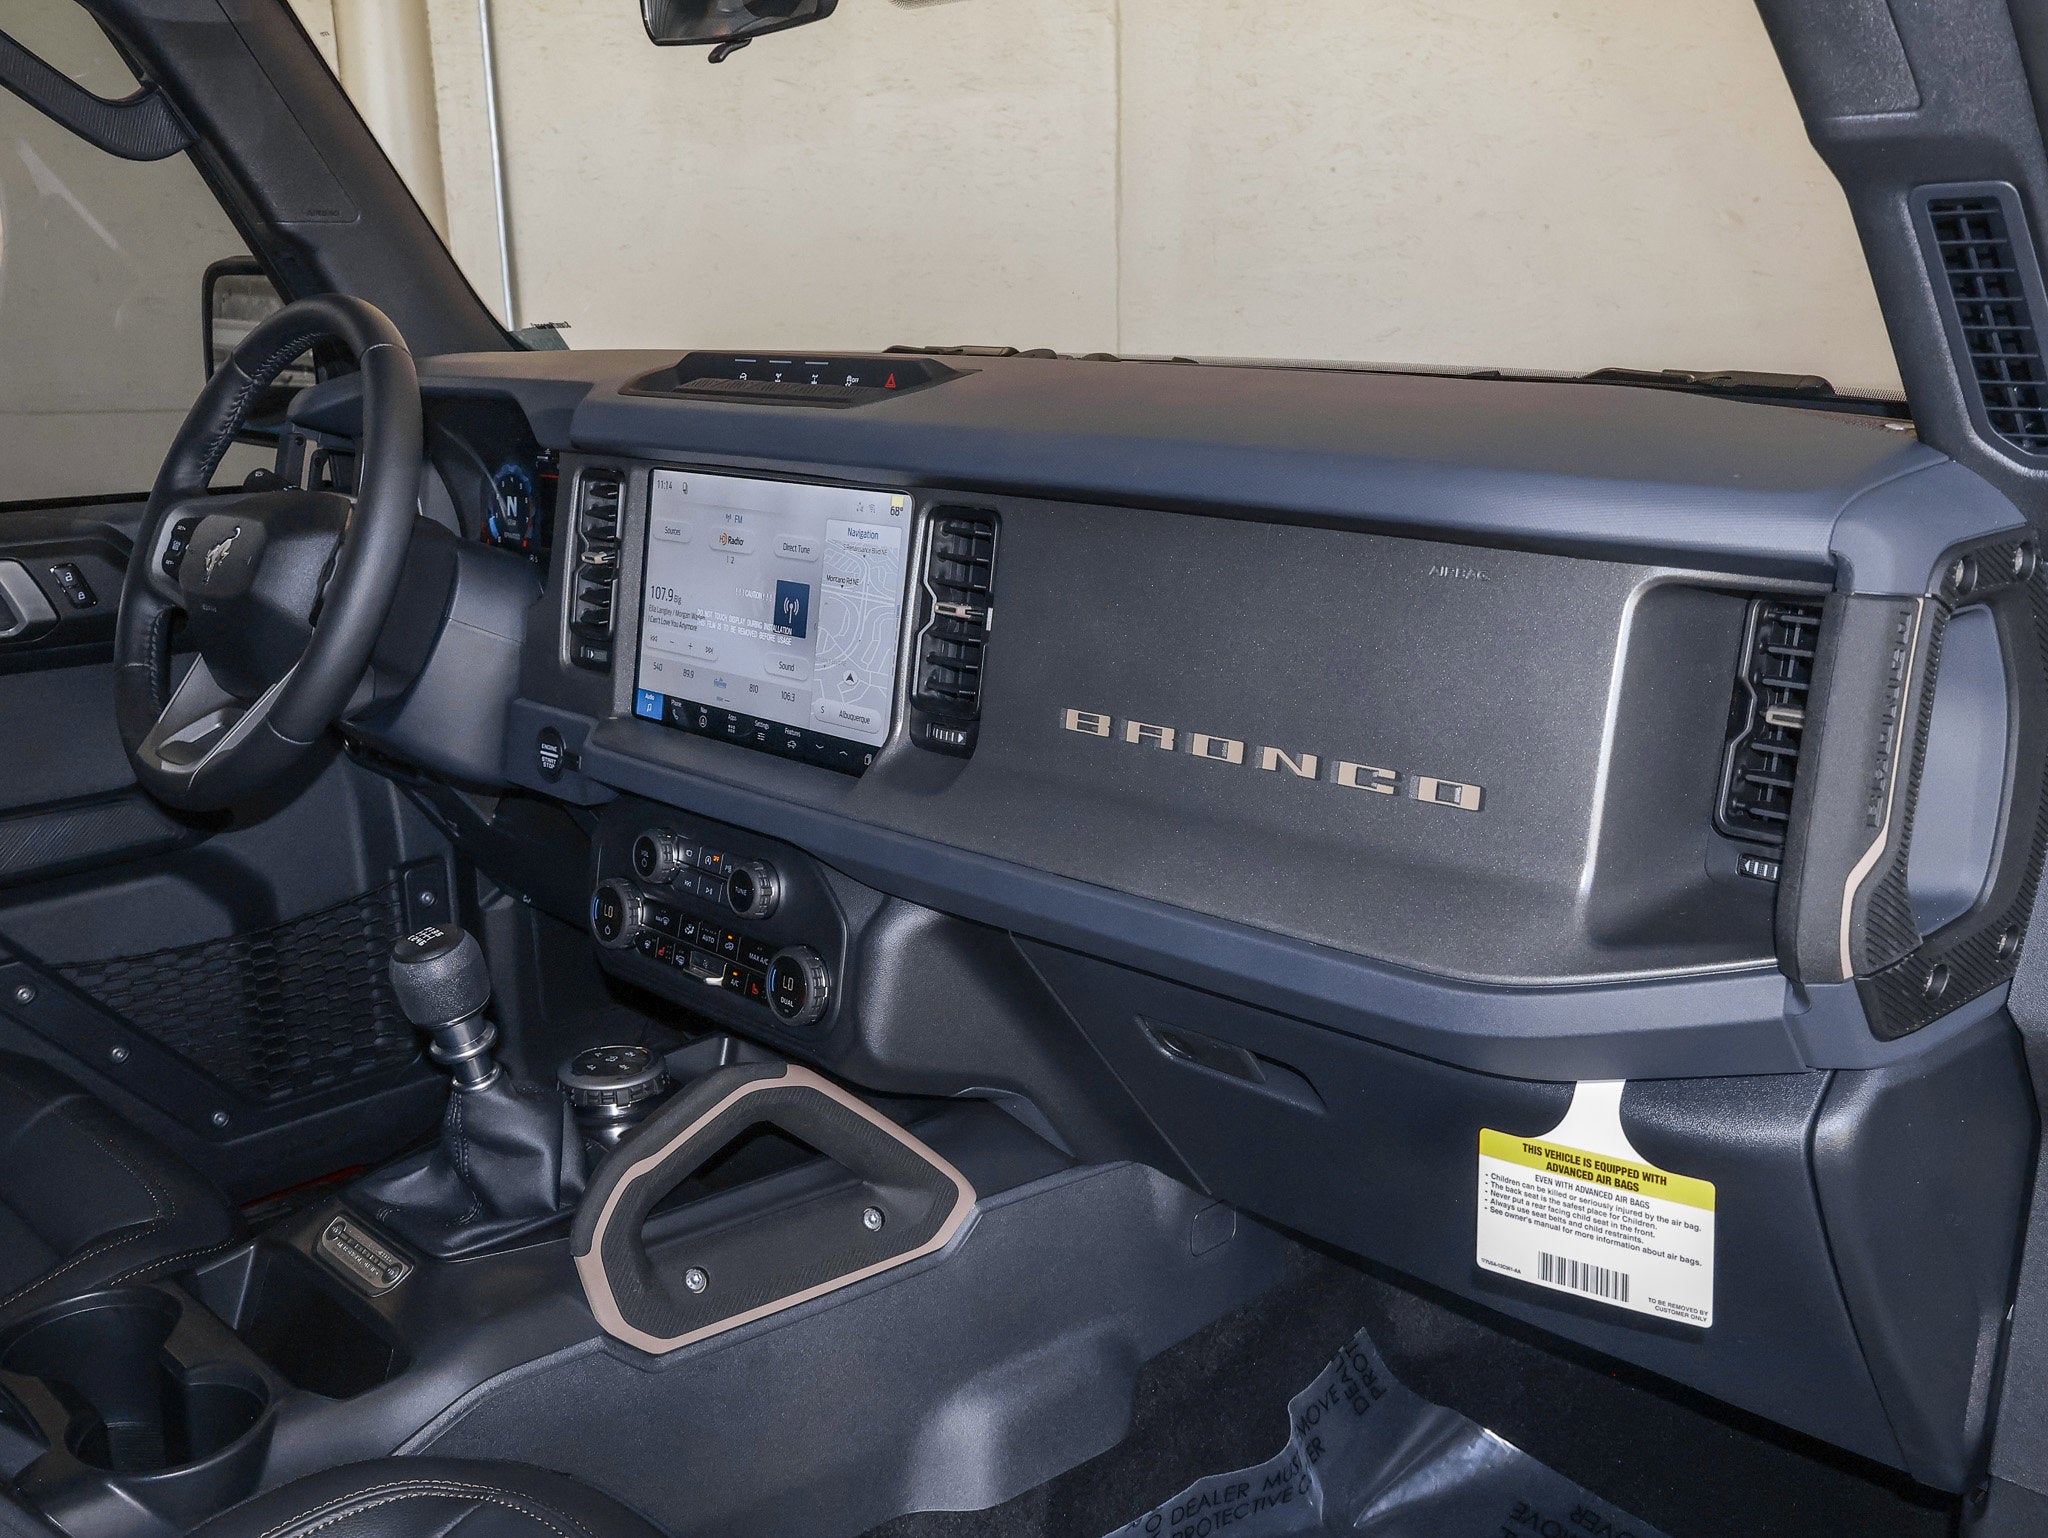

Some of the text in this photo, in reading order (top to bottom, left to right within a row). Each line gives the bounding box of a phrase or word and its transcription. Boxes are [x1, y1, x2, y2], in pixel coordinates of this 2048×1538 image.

[658, 480, 672, 490] 11:14
[507, 496, 517, 517] N
[735, 515, 742, 523] FM
[665, 526, 681, 535] Sources
[848, 528, 878, 540] Navigation
[728, 536, 744, 546] Radio
[783, 543, 810, 554] Direct Tune
[651, 586, 673, 601] 107.9
[764, 622, 792, 635] INSTALLATION
[779, 661, 794, 671] Sound
[653, 662, 662, 671] 540
[683, 669, 694, 678] 89.9
[782, 691, 796, 702] 106.3
[839, 710, 870, 724] Albuquerque
[1062, 708, 1482, 811] BRONCO
[604, 905, 613, 918] LO
[702, 934, 715, 944] AUTO
[749, 952, 769, 966] MAX A/C
[731, 979, 739, 987] A/C
[783, 976, 794, 991] LO
[781, 996, 794, 1007] DUAL
[1522, 1143, 1667, 1185] THIS VEHICLE IS EQUIPPED WITH
[1546, 1162, 1639, 1192] ADVANCED AIR BAGS
[1535, 1175, 1650, 1209] EVEN WITH ADVANCED AIR BAGS
[1491, 1173, 1520, 1187] Children
[1522, 1182, 1535, 1191] can
[1537, 1184, 1545, 1193] be
[1548, 1187, 1567, 1198] killed
[1579, 1196, 1614, 1212] seriously
[1616, 1205, 1642, 1218] injured
[1645, 1212, 1654, 1221] by
[1657, 1215, 1669, 1224] the
[1672, 1218, 1682, 1226] air
[1684, 1221, 1702, 1232] bag.
[1491, 1181, 1503, 1190] The
[1506, 1184, 1522, 1196] back
[1524, 1191, 1539, 1200] seat
[1549, 1196, 1560, 1205] the
[1563, 1200, 1585, 1212] safest
[1587, 1206, 1607, 1217] place
[1609, 1211, 1620, 1220] for
[1622, 1215, 1657, 1230] Children.
[1490, 1198, 1644, 1244] Always use seat belts and child restraints.
[1491, 1190, 1510, 1201] Never
[1512, 1196, 1523, 1205] put
[1532, 1201, 1546, 1210] rear
[1548, 1204, 1570, 1218] facing
[1573, 1211, 1590, 1222] child
[1593, 1217, 1608, 1226] seat
[1611, 1220, 1618, 1228] in
[1620, 1223, 1632, 1232] the
[1634, 1228, 1655, 1238] front.
[1490, 1206, 1702, 1267] See owner's manual for more information about air bags.
[1655, 1306, 1707, 1322] CUSTOMER ONLY
[1668, 1302, 1698, 1314] REMOVED
[1335, 1355, 1370, 1416] DEAL
[1295, 1384, 1340, 1436] MOVE
[1170, 1482, 1250, 1526] DEALER
[1263, 1450, 1300, 1492] MUS
